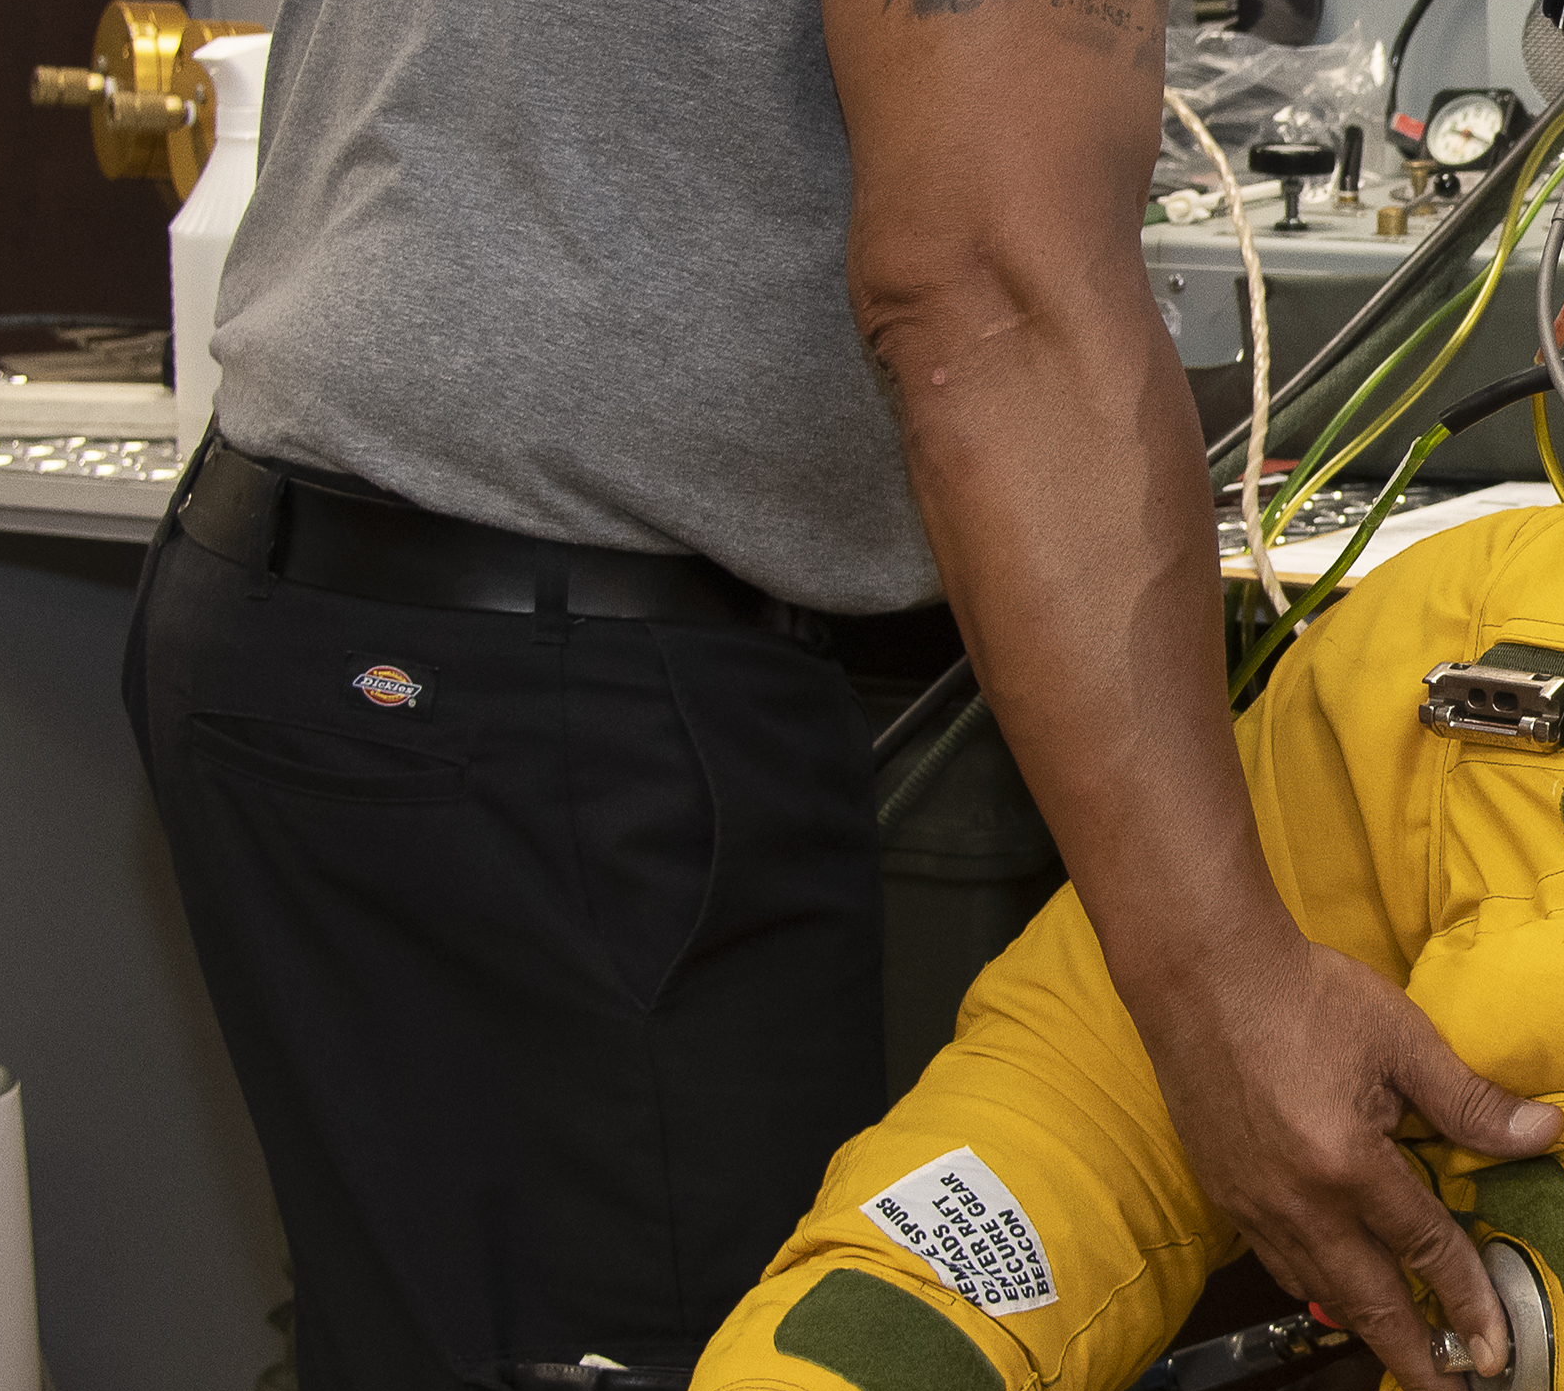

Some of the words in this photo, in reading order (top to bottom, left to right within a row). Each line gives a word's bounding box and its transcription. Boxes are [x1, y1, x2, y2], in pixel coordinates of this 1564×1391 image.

[360, 676, 415, 695] Dickies
[931, 1195, 978, 1238] RAFT
[940, 1172, 987, 1217] GEAR
[876, 1197, 927, 1245] SPURS
[932, 1224, 985, 1277] LEADS
[970, 1238, 1019, 1301] ENTER
[980, 1218, 1036, 1299] SECURE
[998, 1208, 1050, 1297] BEACON
